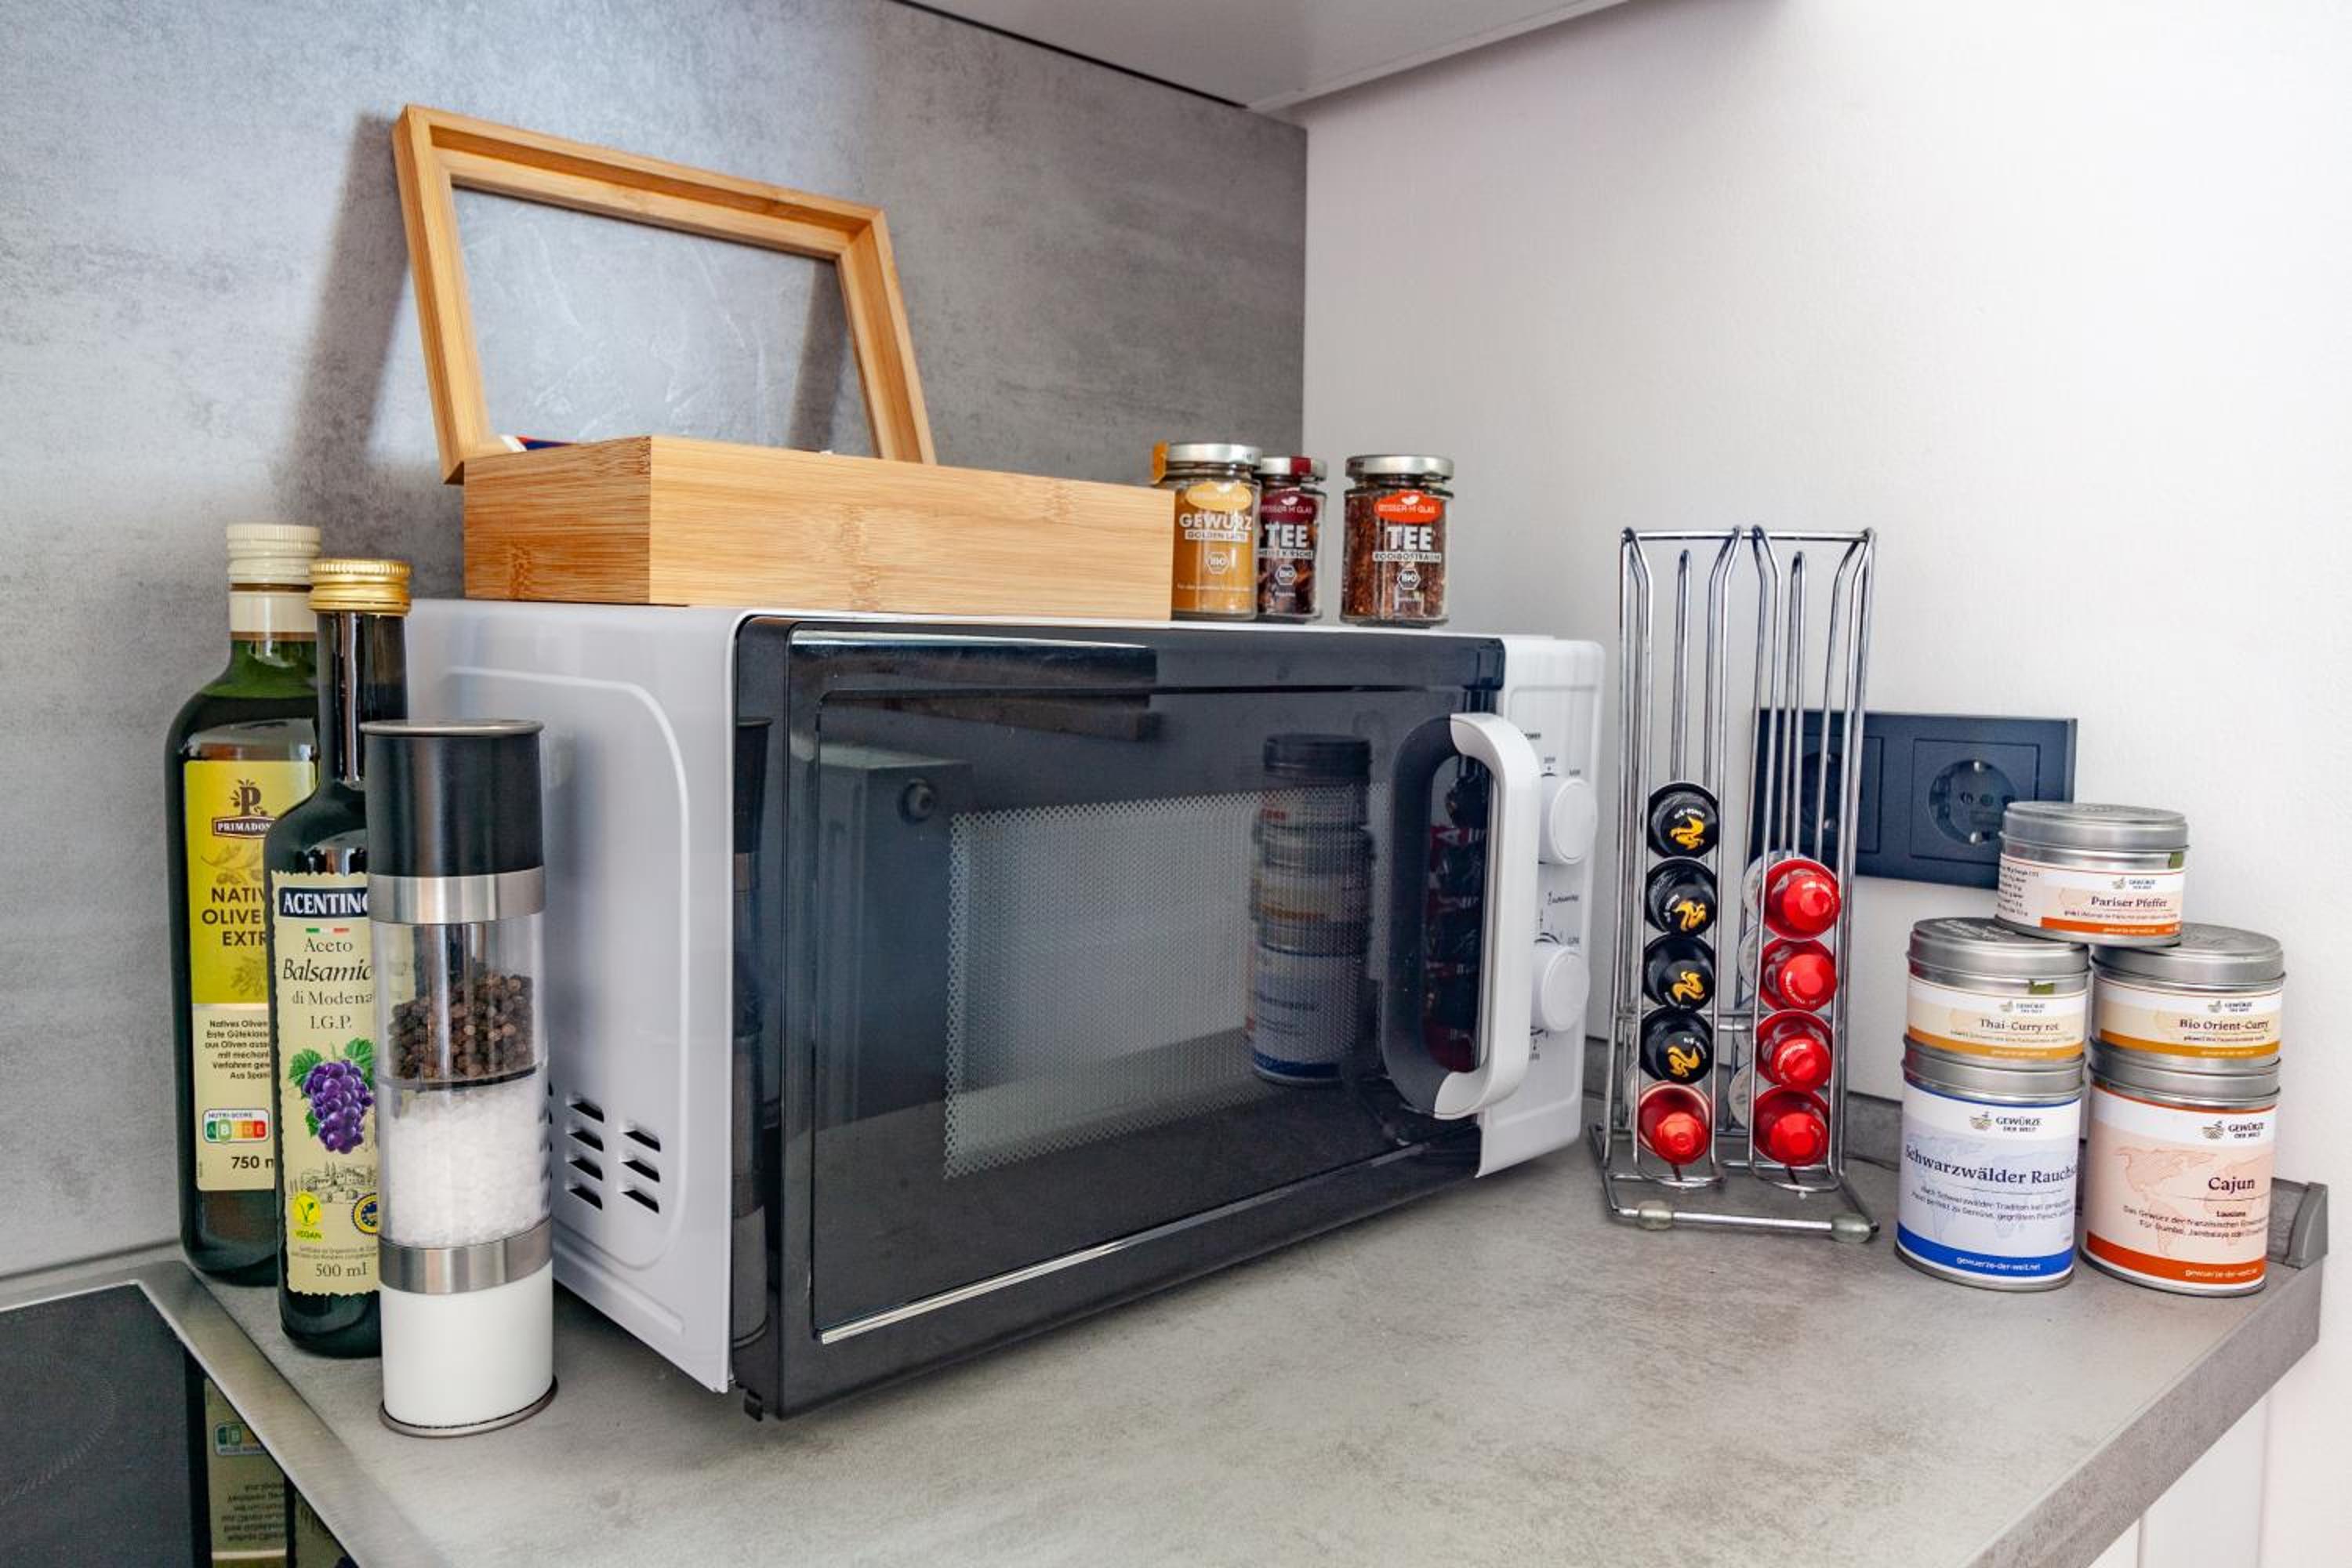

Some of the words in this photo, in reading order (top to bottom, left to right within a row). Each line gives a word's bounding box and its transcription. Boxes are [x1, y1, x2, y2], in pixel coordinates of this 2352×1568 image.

[1265, 523, 1308, 547] TEE
[1387, 526, 1432, 550] TEE
[2091, 895, 2132, 907] Pariser
[201, 909, 261, 924] OLIVE
[223, 931, 267, 946] EXTR
[304, 936, 353, 953] Aceto
[283, 957, 372, 982] Balsamic
[292, 990, 304, 1004] di
[308, 991, 374, 1005] Modena
[1980, 1018, 2042, 1033] Thai-Curry
[2180, 1018, 2201, 1029] Bio
[1995, 1116, 2042, 1127] GEWÜRZE
[231, 1155, 260, 1169] 750
[2208, 1177, 2256, 1194] Cajun
[315, 1263, 342, 1277] 500
[346, 1261, 368, 1276] ml
